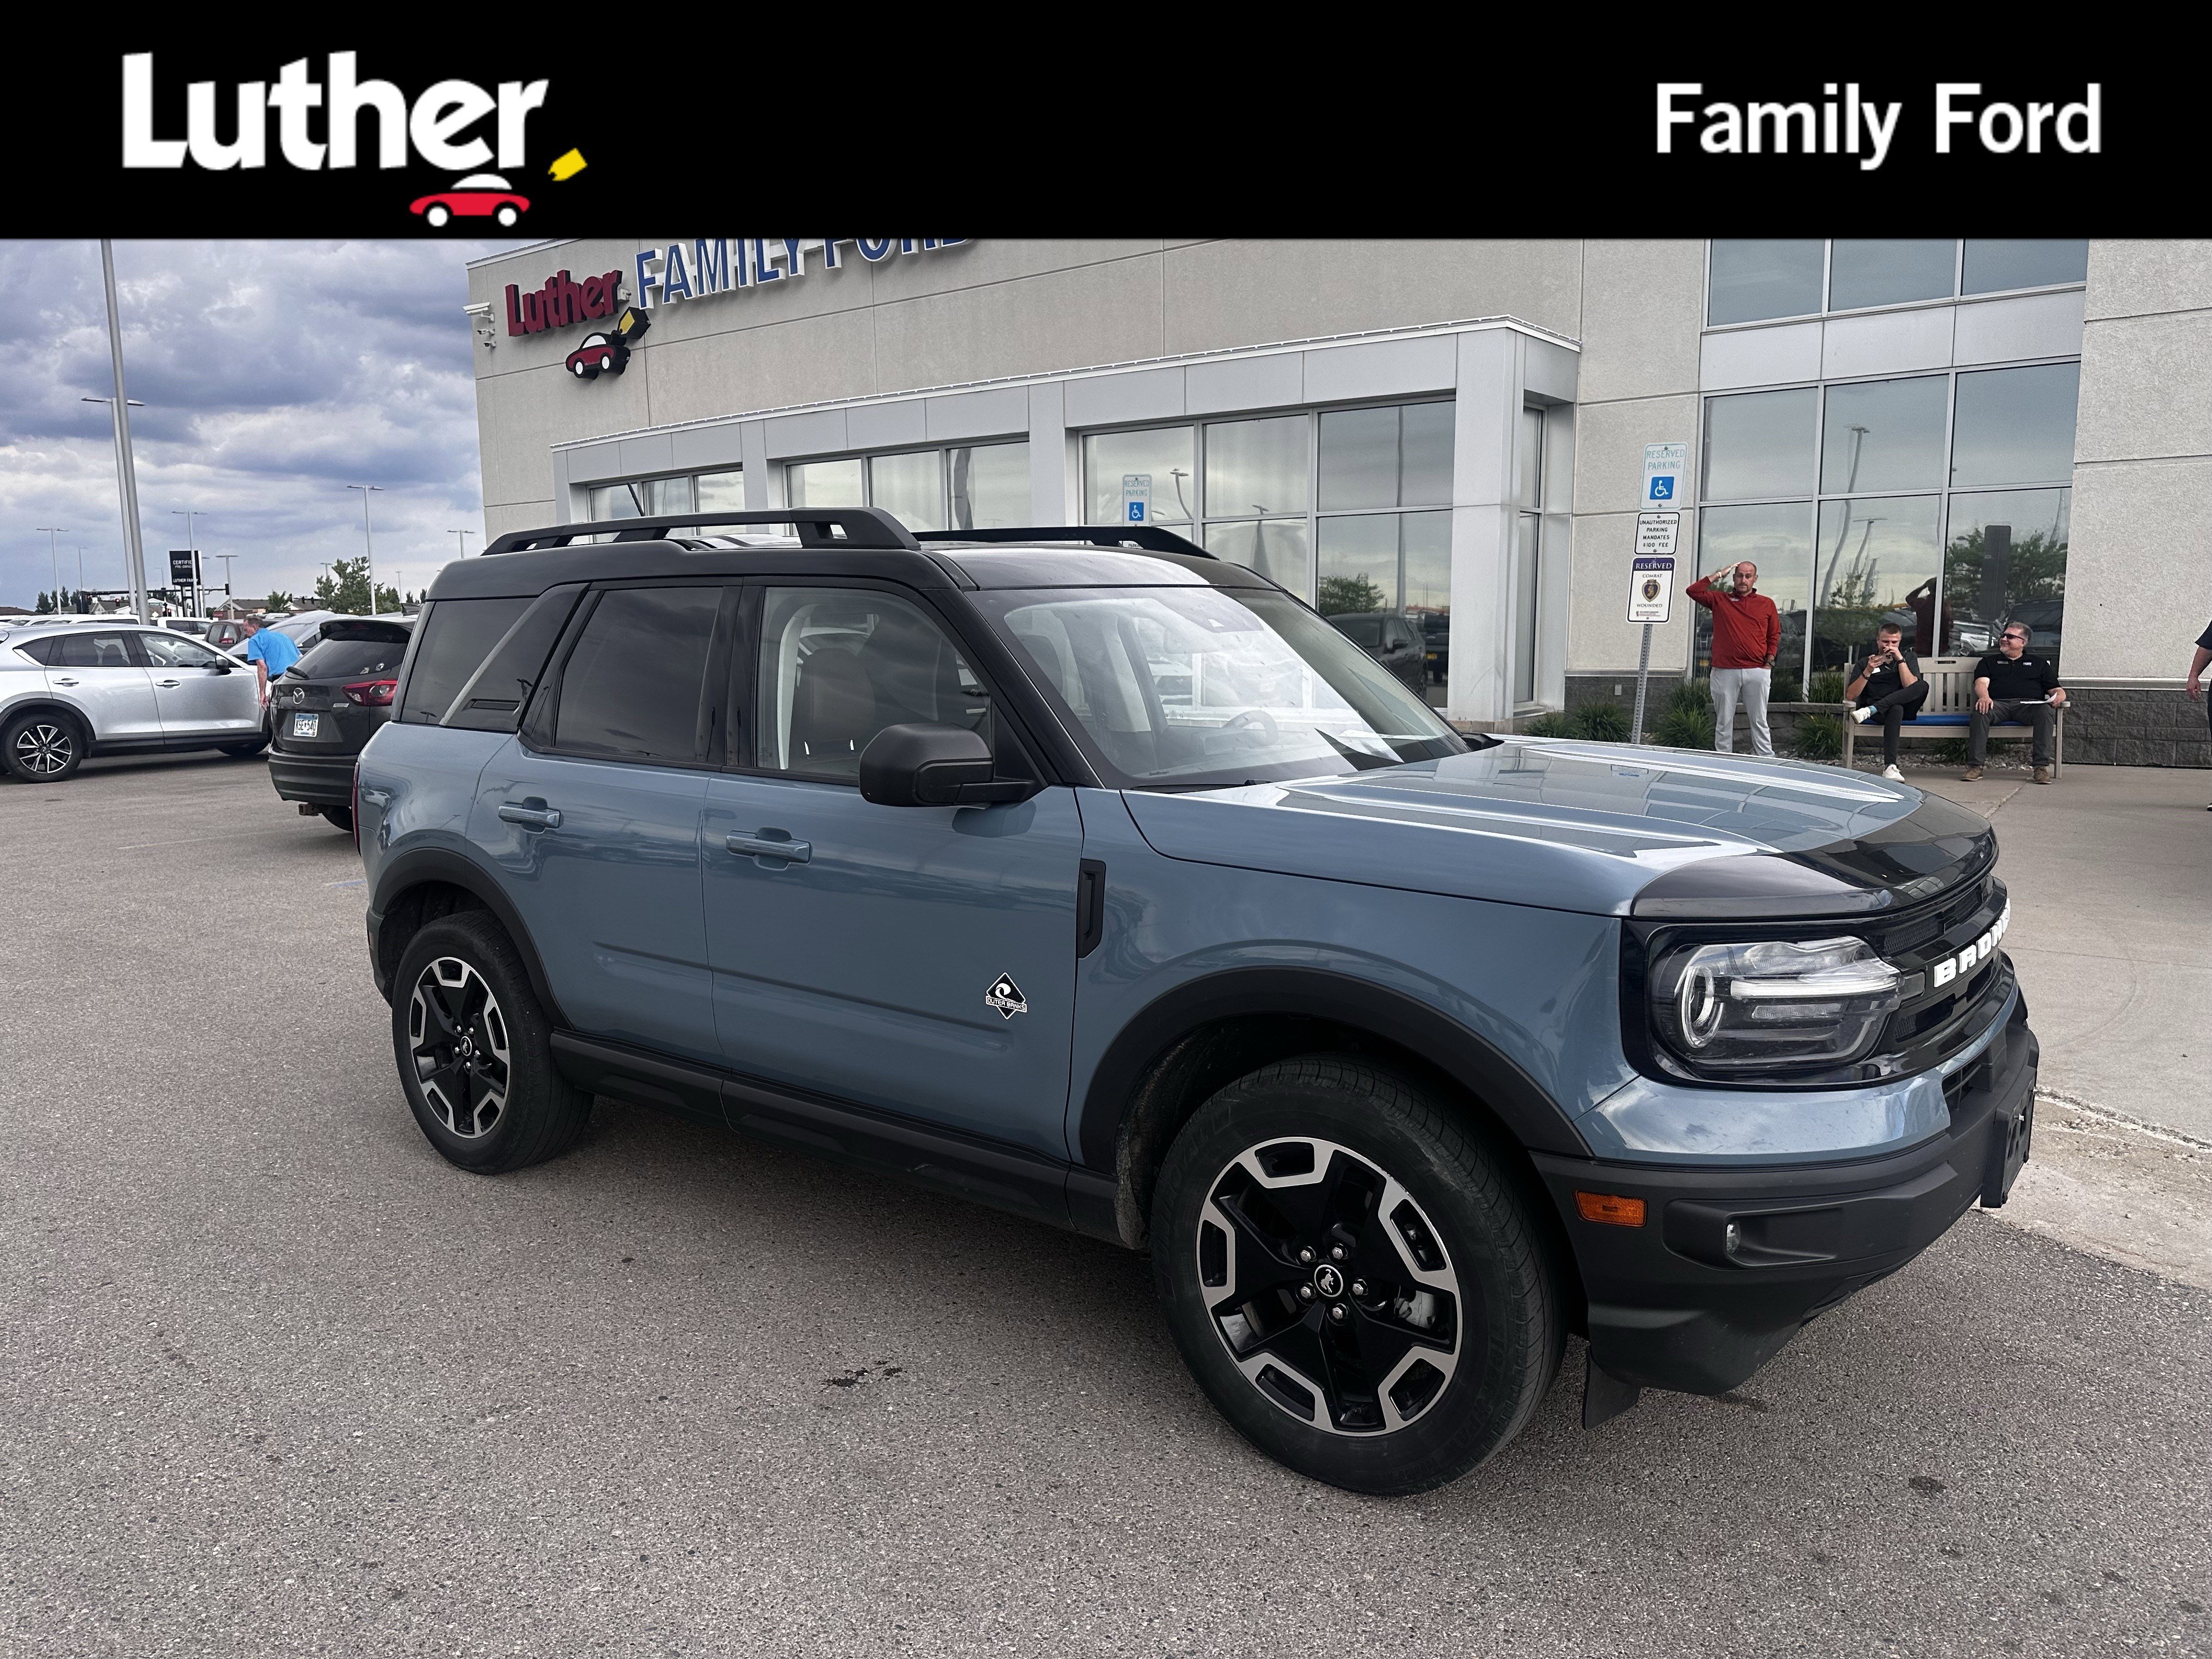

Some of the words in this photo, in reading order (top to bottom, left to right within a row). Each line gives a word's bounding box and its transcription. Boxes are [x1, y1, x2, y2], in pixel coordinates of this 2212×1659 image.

[635, 238, 803, 309] FAMILY
[505, 269, 622, 336] Luther
[1646, 449, 1685, 459] RESERVED
[1648, 461, 1680, 470] PARKING
[988, 998, 1005, 1006] OUTER
[1007, 1002, 1025, 1011] BANKS
